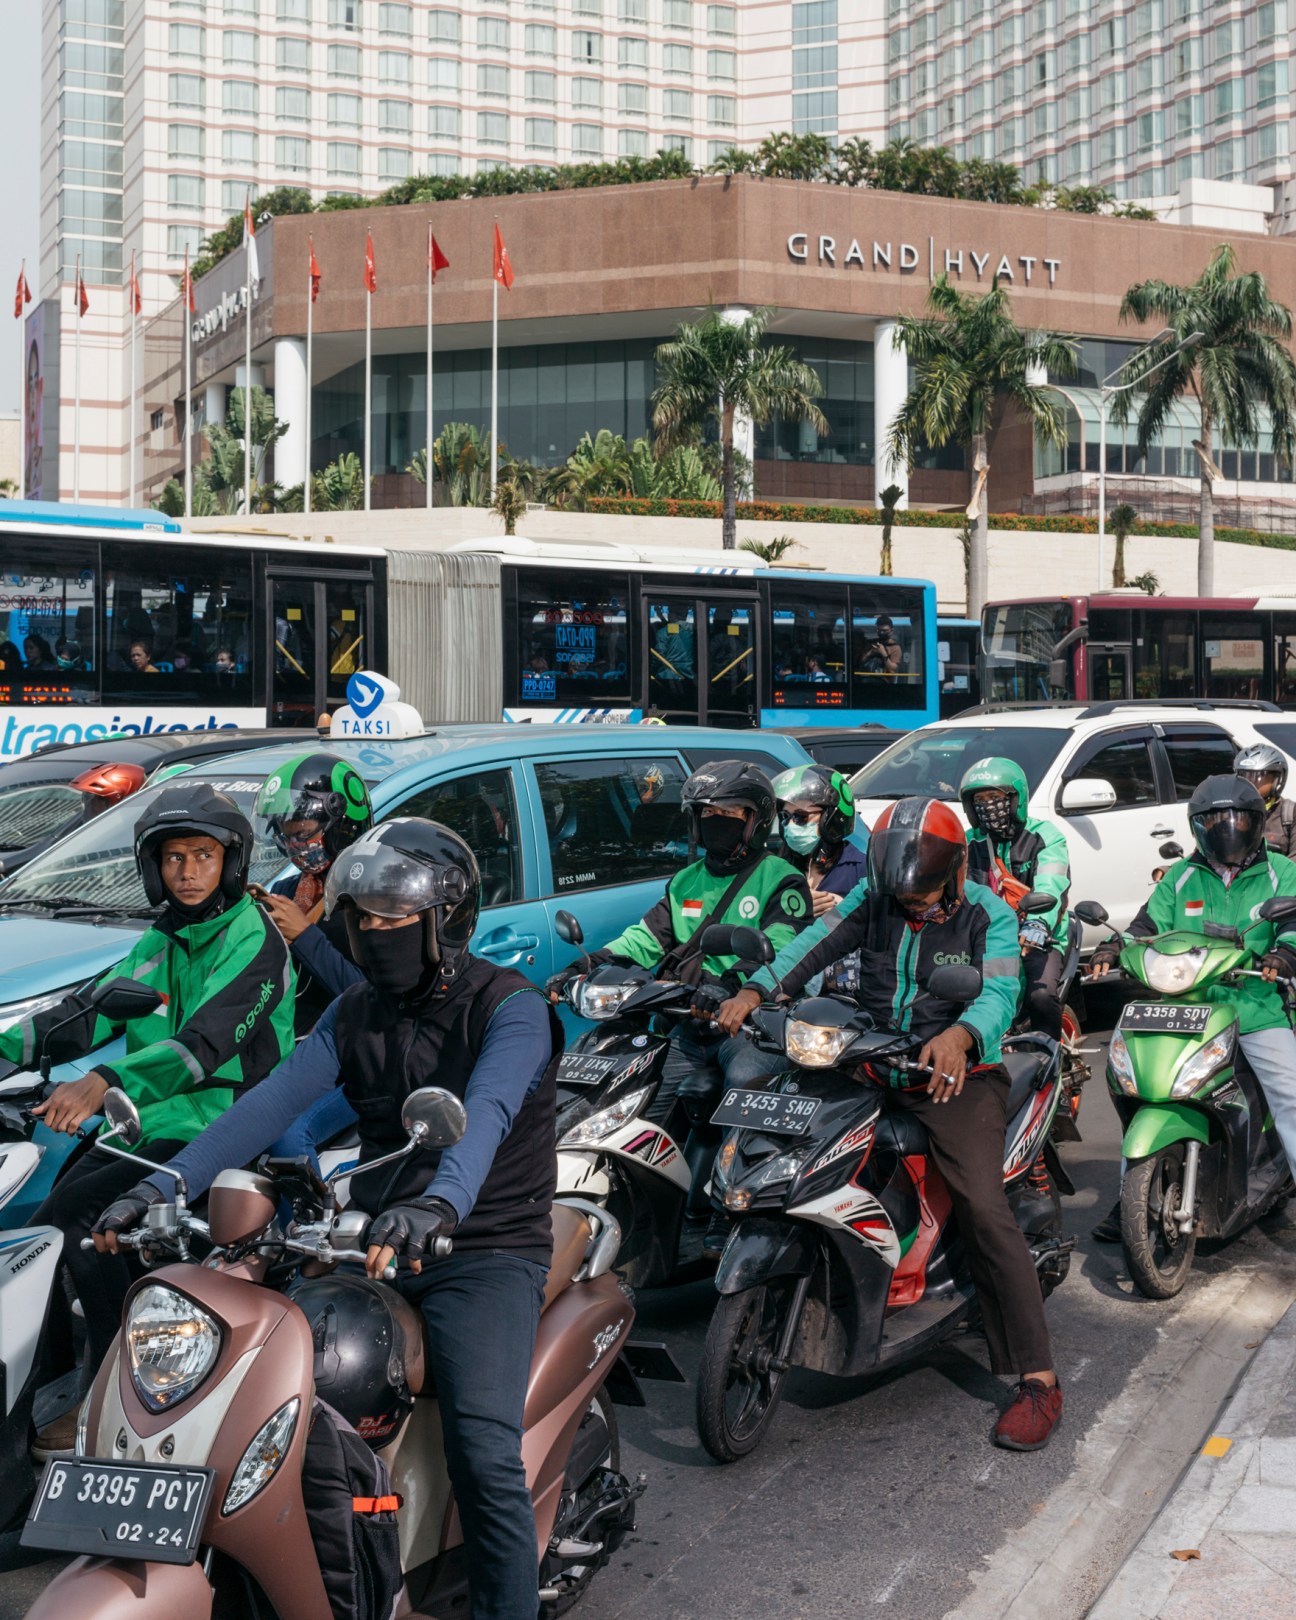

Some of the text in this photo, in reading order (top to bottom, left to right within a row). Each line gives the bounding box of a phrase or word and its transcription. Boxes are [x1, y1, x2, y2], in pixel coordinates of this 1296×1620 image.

[787, 233, 1062, 282] GRAND HYATT
[524, 679, 554, 690] PPD-0747
[342, 720, 390, 734] TAKSI
[933, 950, 971, 966] Grab
[245, 978, 275, 1029] gojek
[1125, 1006, 1135, 1017] B
[1143, 1006, 1177, 1018] 3358
[560, 1055, 613, 1071] 671 UXM
[724, 1092, 816, 1116] B 3455 SNB
[834, 1200, 853, 1214] YAMAHA
[11, 1241, 52, 1274] HONDA
[47, 1469, 200, 1513] B 3395 PGY
